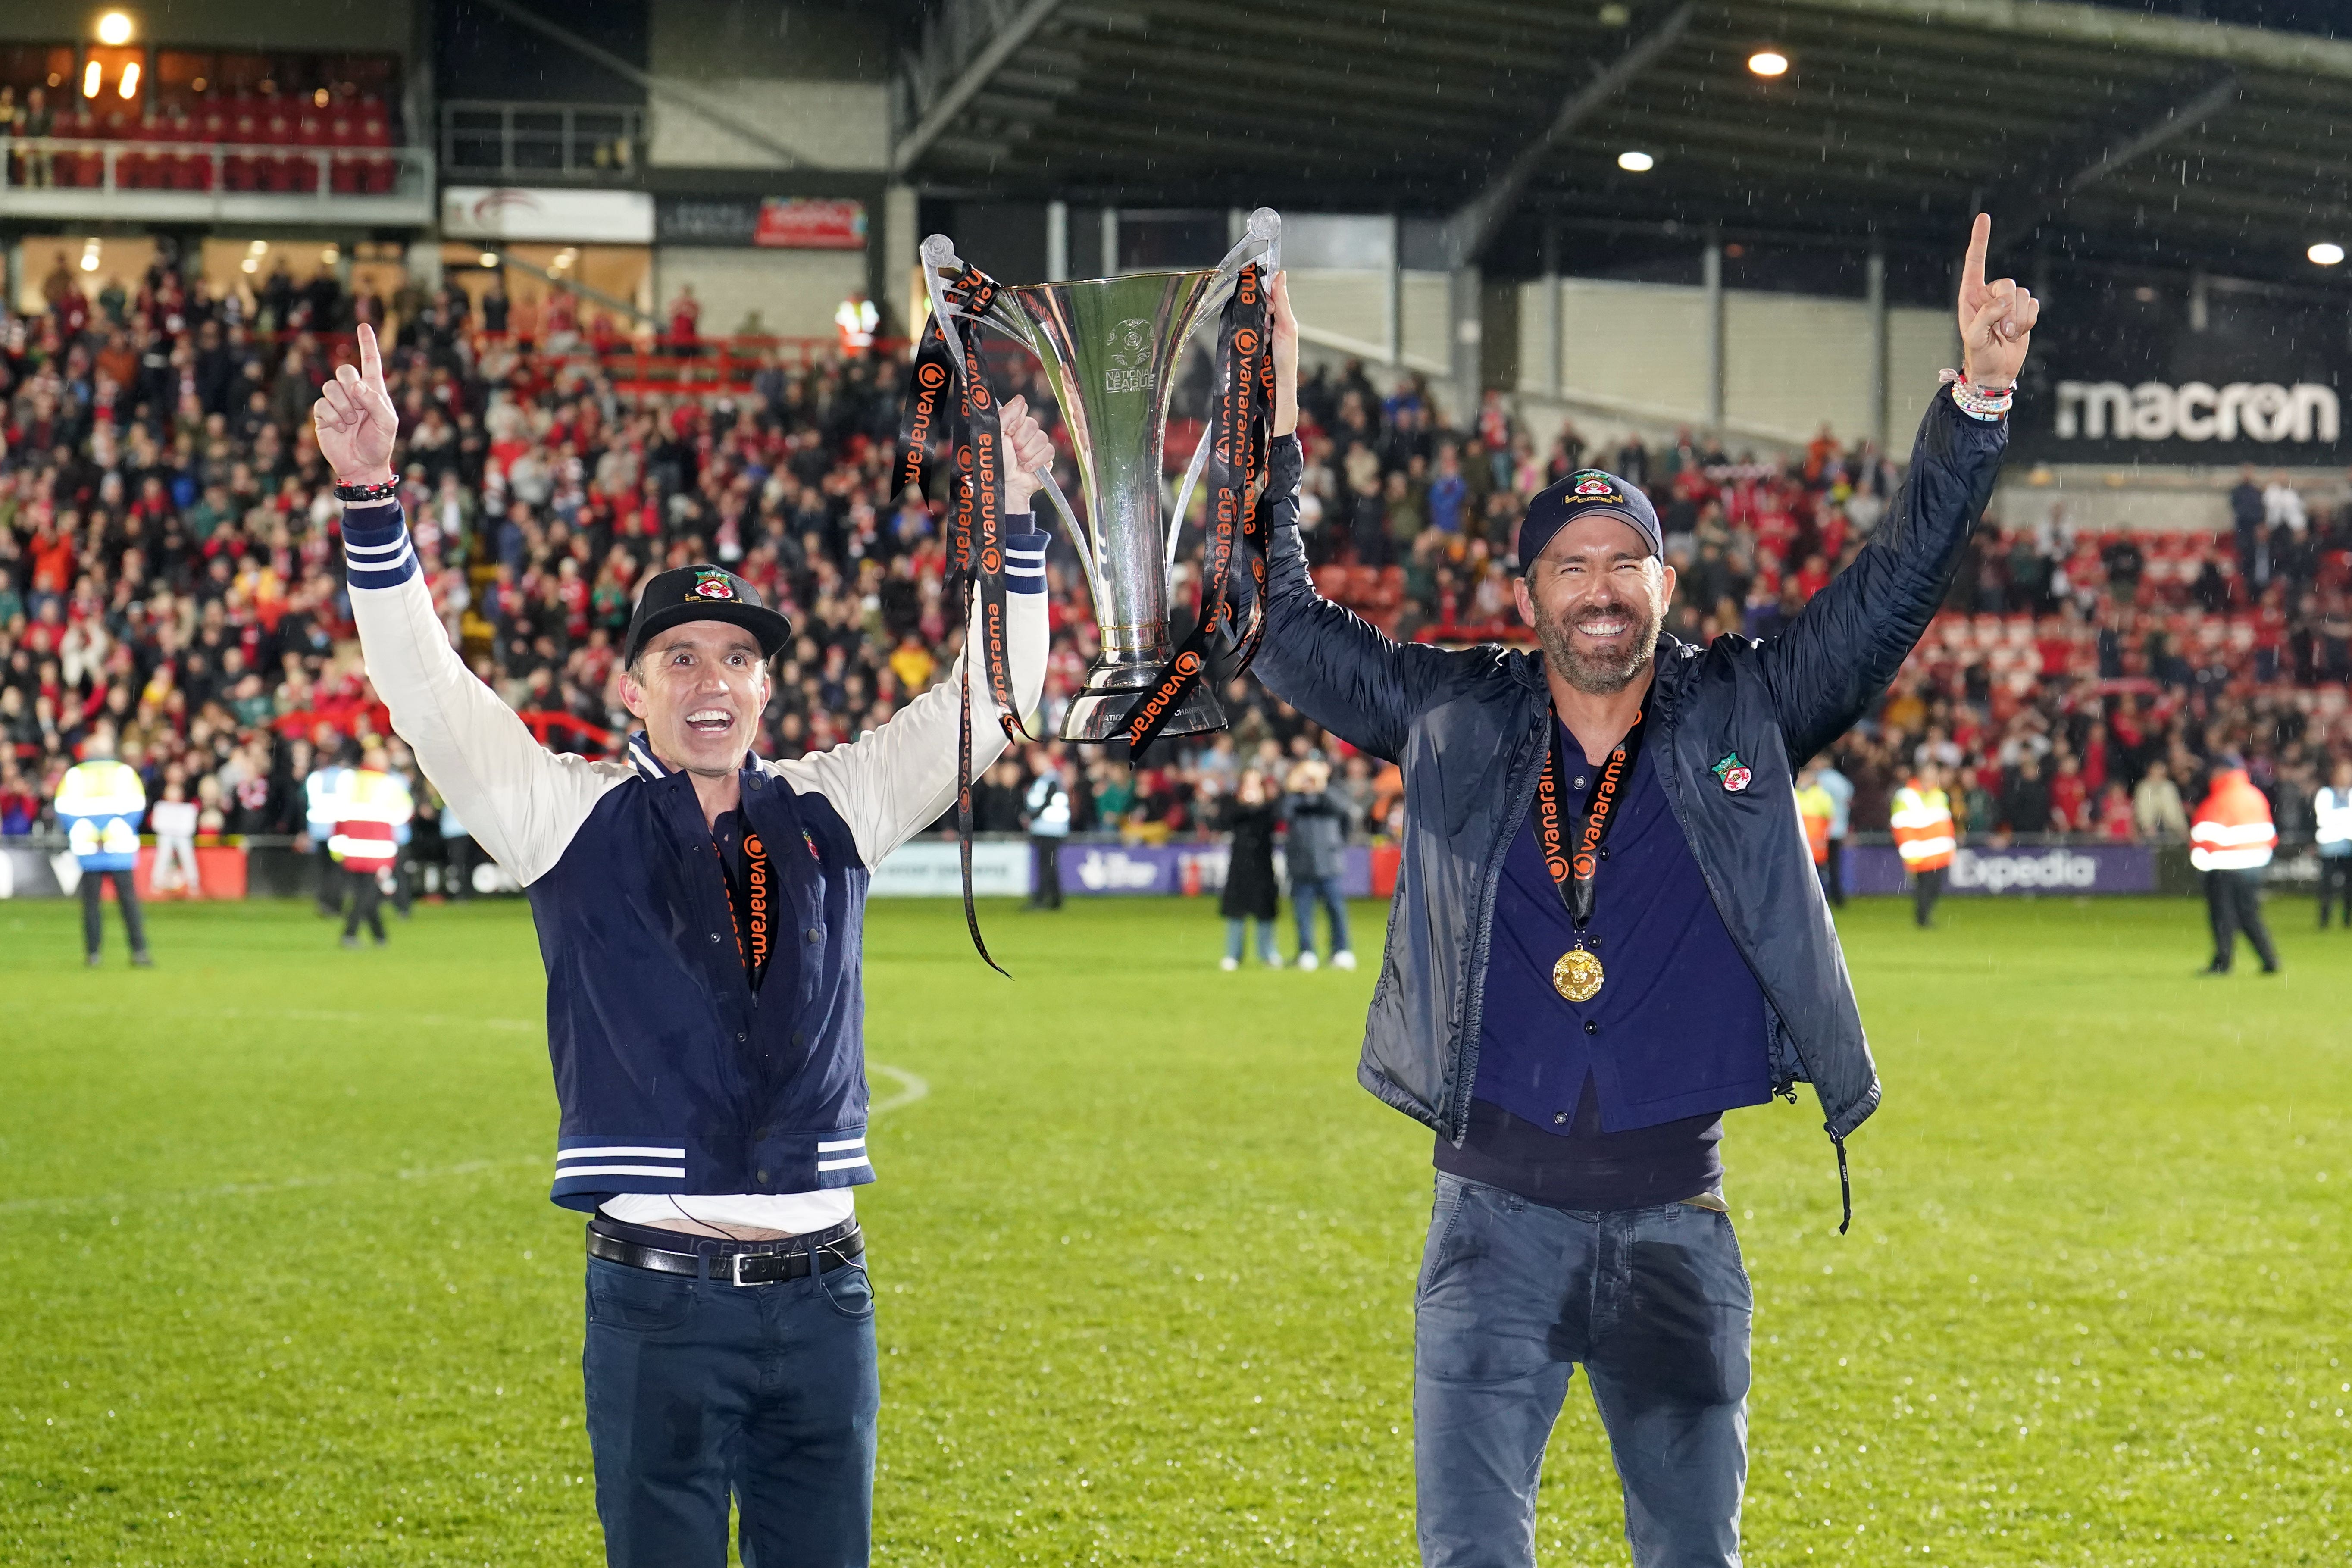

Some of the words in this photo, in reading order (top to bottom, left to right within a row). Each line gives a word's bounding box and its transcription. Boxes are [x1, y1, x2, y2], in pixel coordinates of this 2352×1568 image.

[1106, 369, 1154, 381] NATIONAL
[1106, 376, 1154, 391] LEAGUE
[1234, 357, 1252, 466] vanarama
[2055, 380, 2340, 443] macron
[979, 434, 997, 545] vanarama
[988, 603, 1012, 714] vanarama
[1581, 750, 1626, 851] vanarama
[1949, 848, 2096, 894] Expedia
